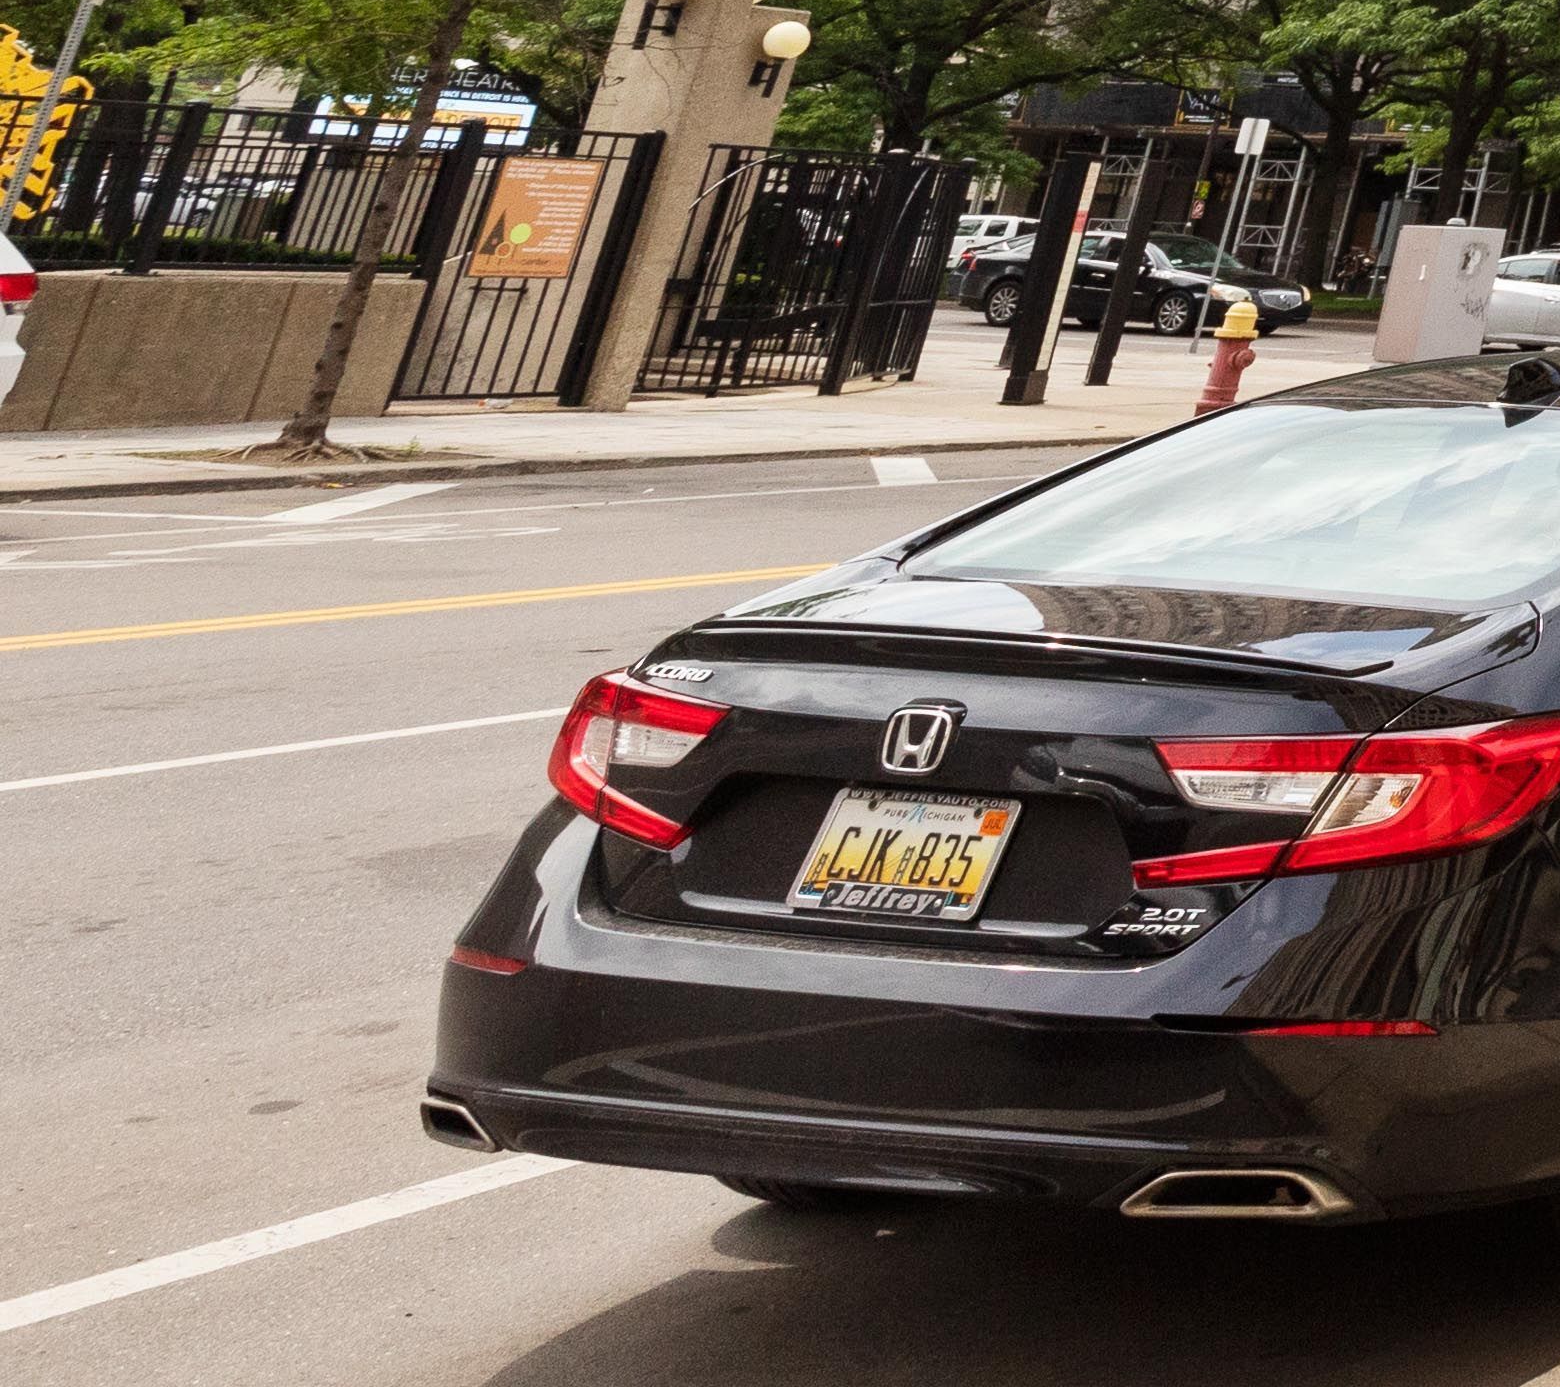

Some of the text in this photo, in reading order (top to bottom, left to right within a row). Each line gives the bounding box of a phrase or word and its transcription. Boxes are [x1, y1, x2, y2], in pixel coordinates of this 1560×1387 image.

[850, 789, 1009, 809] WWW.JEFFREYAUTO.COM
[884, 804, 966, 824] PURE MICHIGAN
[827, 826, 983, 887] CJK 835
[832, 884, 936, 916] Jeffrey
[1141, 908, 1206, 922] 2.0T
[1103, 924, 1200, 936] SPORT
